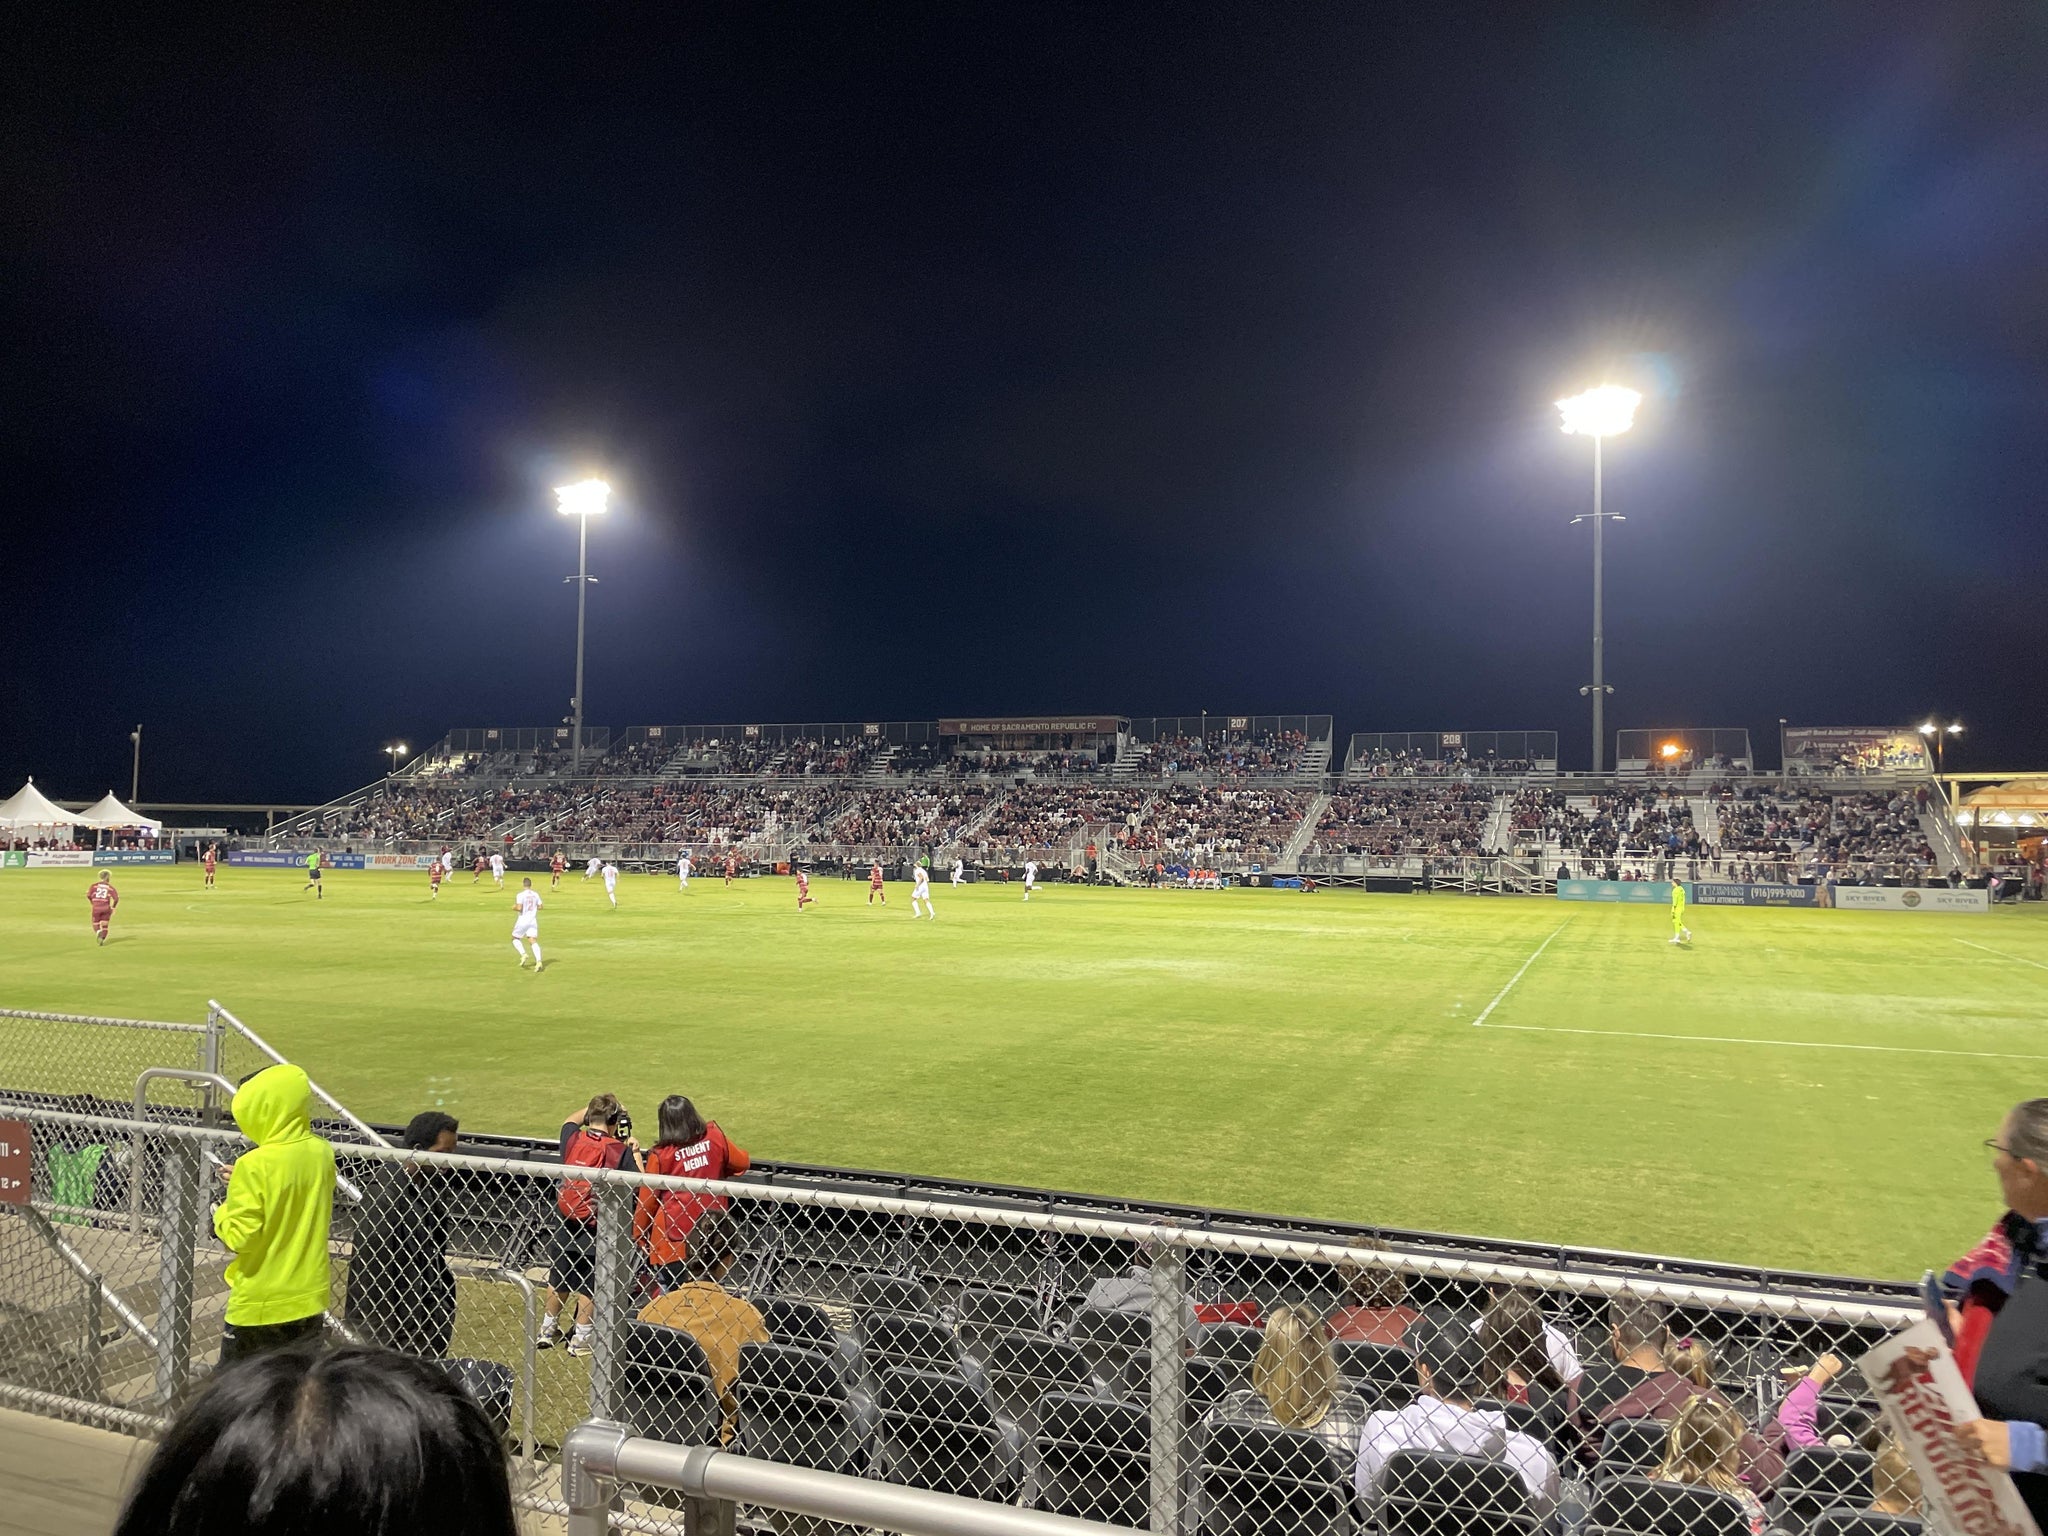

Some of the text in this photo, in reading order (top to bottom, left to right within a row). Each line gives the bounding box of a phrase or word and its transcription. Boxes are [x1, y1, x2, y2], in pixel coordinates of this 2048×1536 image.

[1001, 723, 1049, 731] SACRAMENTO
[1050, 722, 1086, 730] REPUBLIC
[1231, 718, 1247, 729] 207
[745, 726, 759, 735] 204
[865, 725, 879, 734] 205
[1443, 734, 1461, 744] 208
[374, 855, 397, 864] WORK
[398, 855, 418, 864] ZONE
[417, 856, 437, 864] ALERT
[95, 887, 108, 898] 23
[1751, 887, 1805, 899] (916)999-9000
[1716, 896, 1745, 904] ATTORNEYS
[674, 1140, 711, 1162] STUDENT
[683, 1155, 709, 1172] MEDIA
